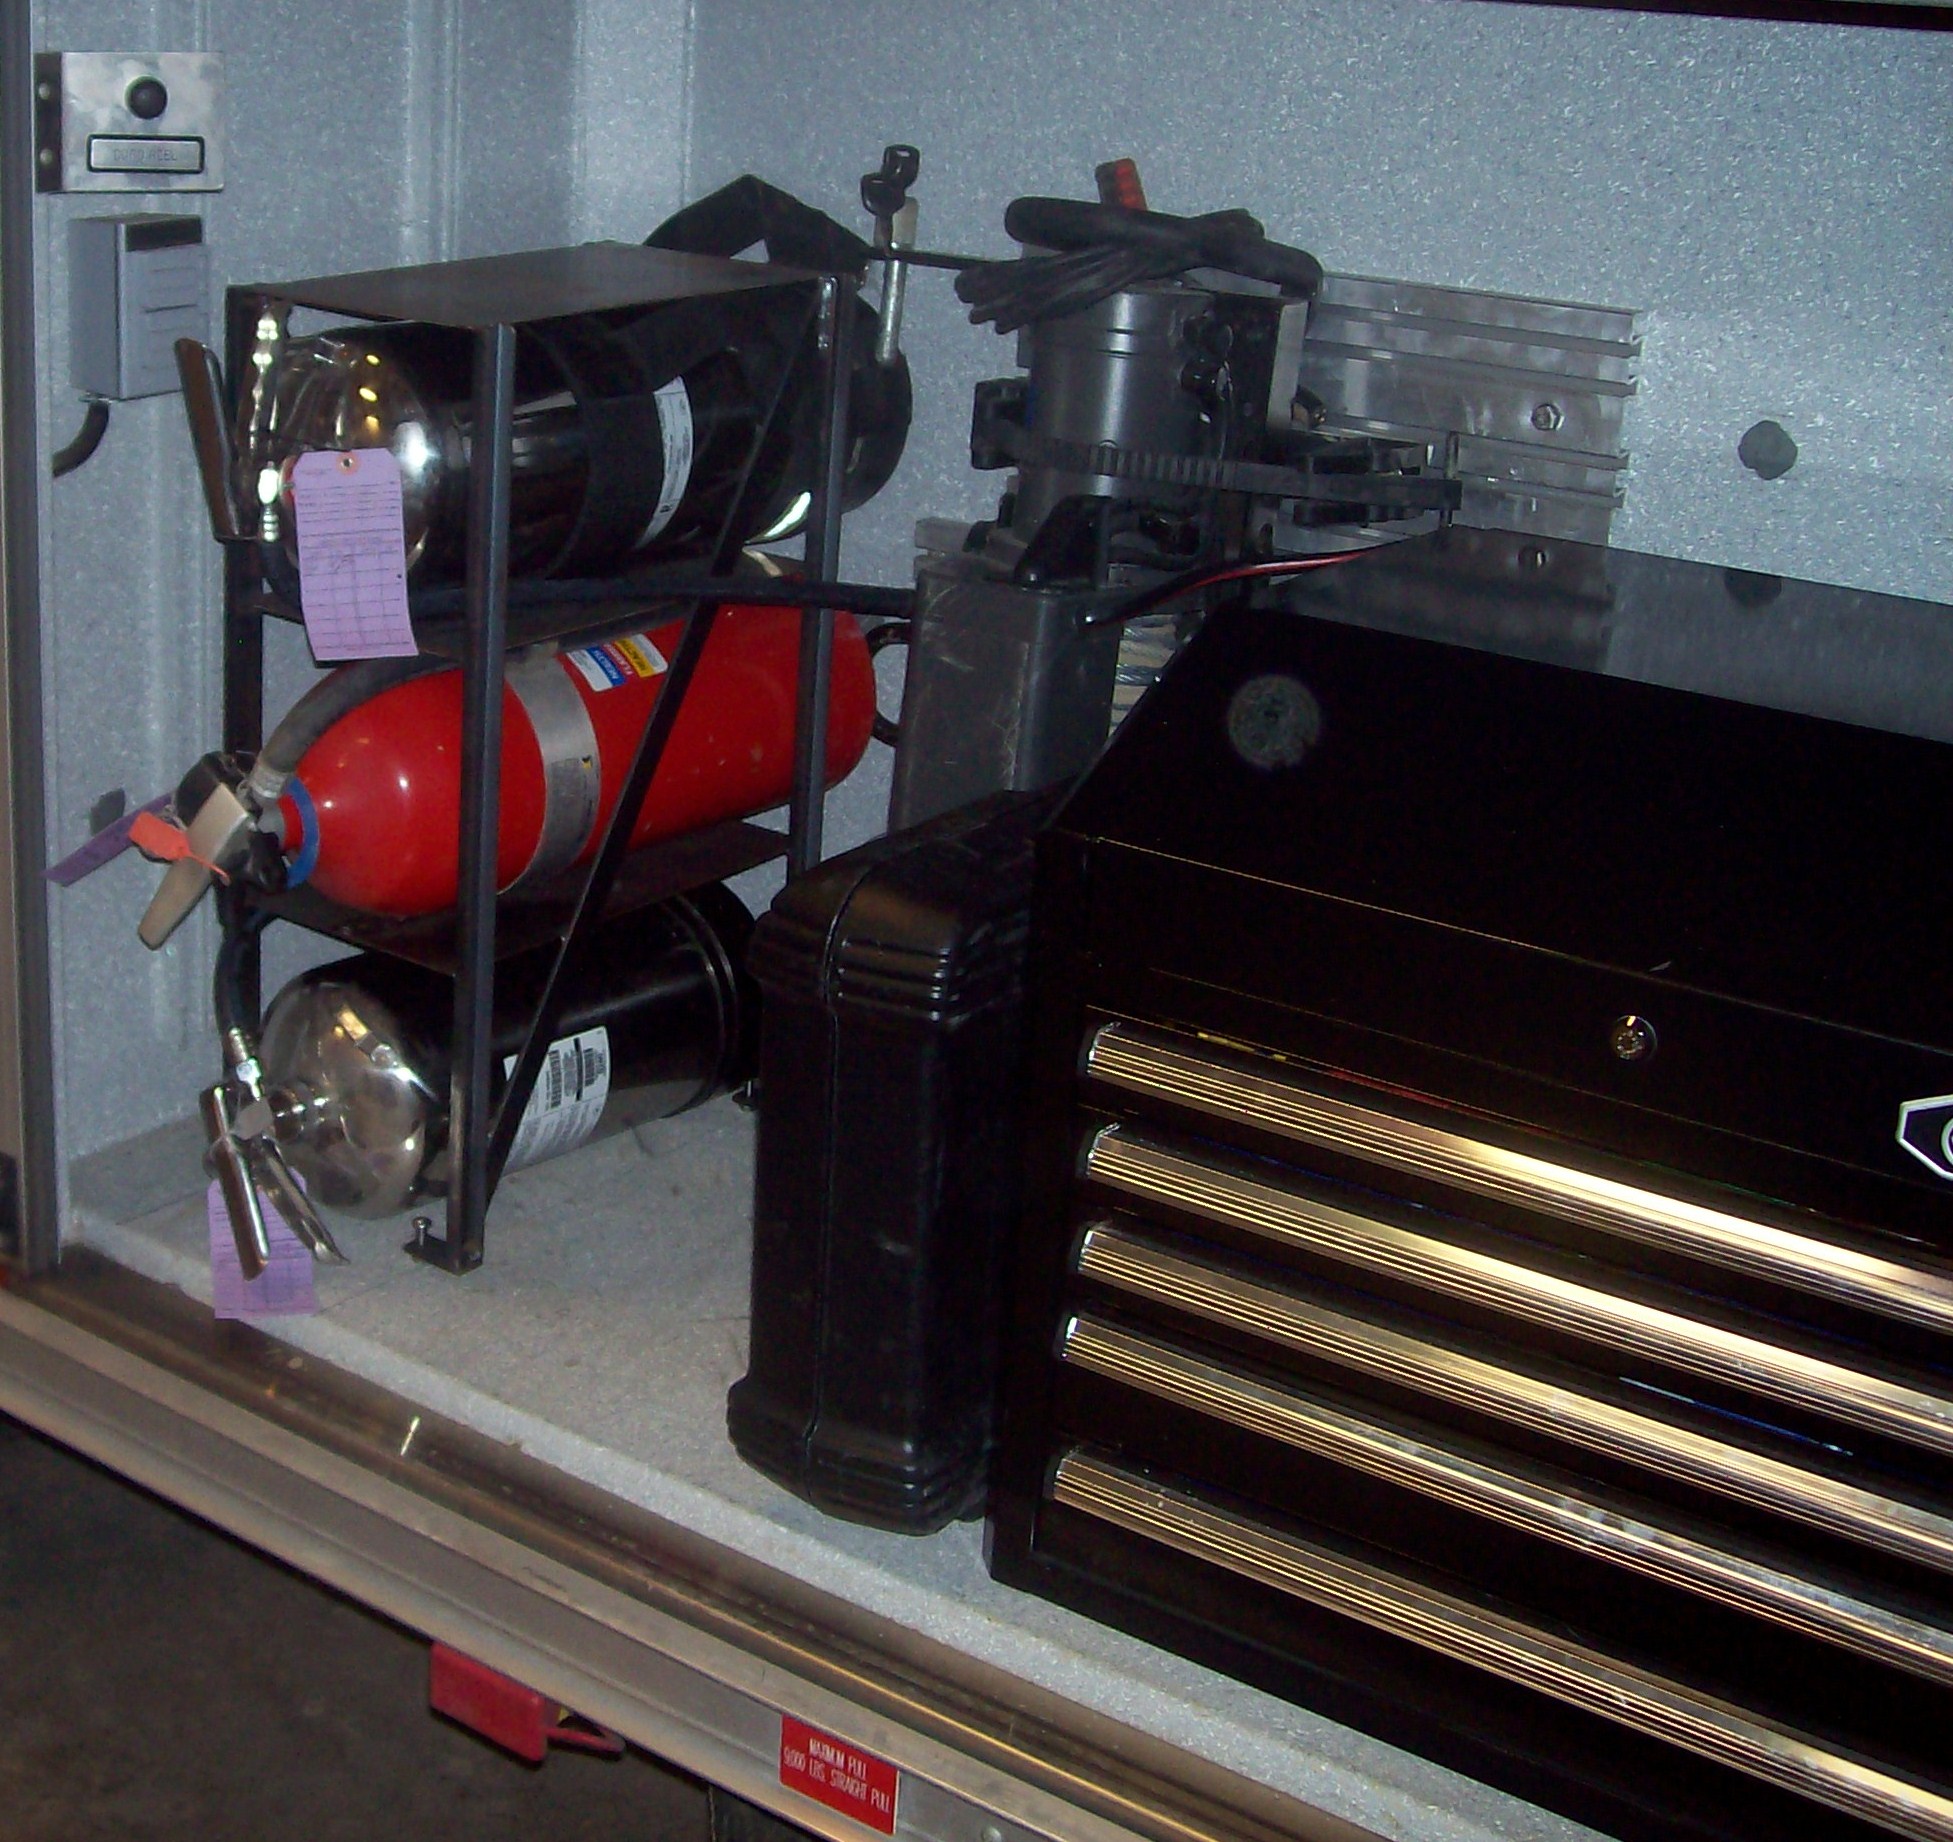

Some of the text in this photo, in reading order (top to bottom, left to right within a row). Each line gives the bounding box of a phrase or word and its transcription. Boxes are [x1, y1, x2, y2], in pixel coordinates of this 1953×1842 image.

[809, 1738, 867, 1781] MAXIMUM PULL
[829, 1769, 868, 1800] STRAIGHT
[871, 1788, 890, 1813] PULL
